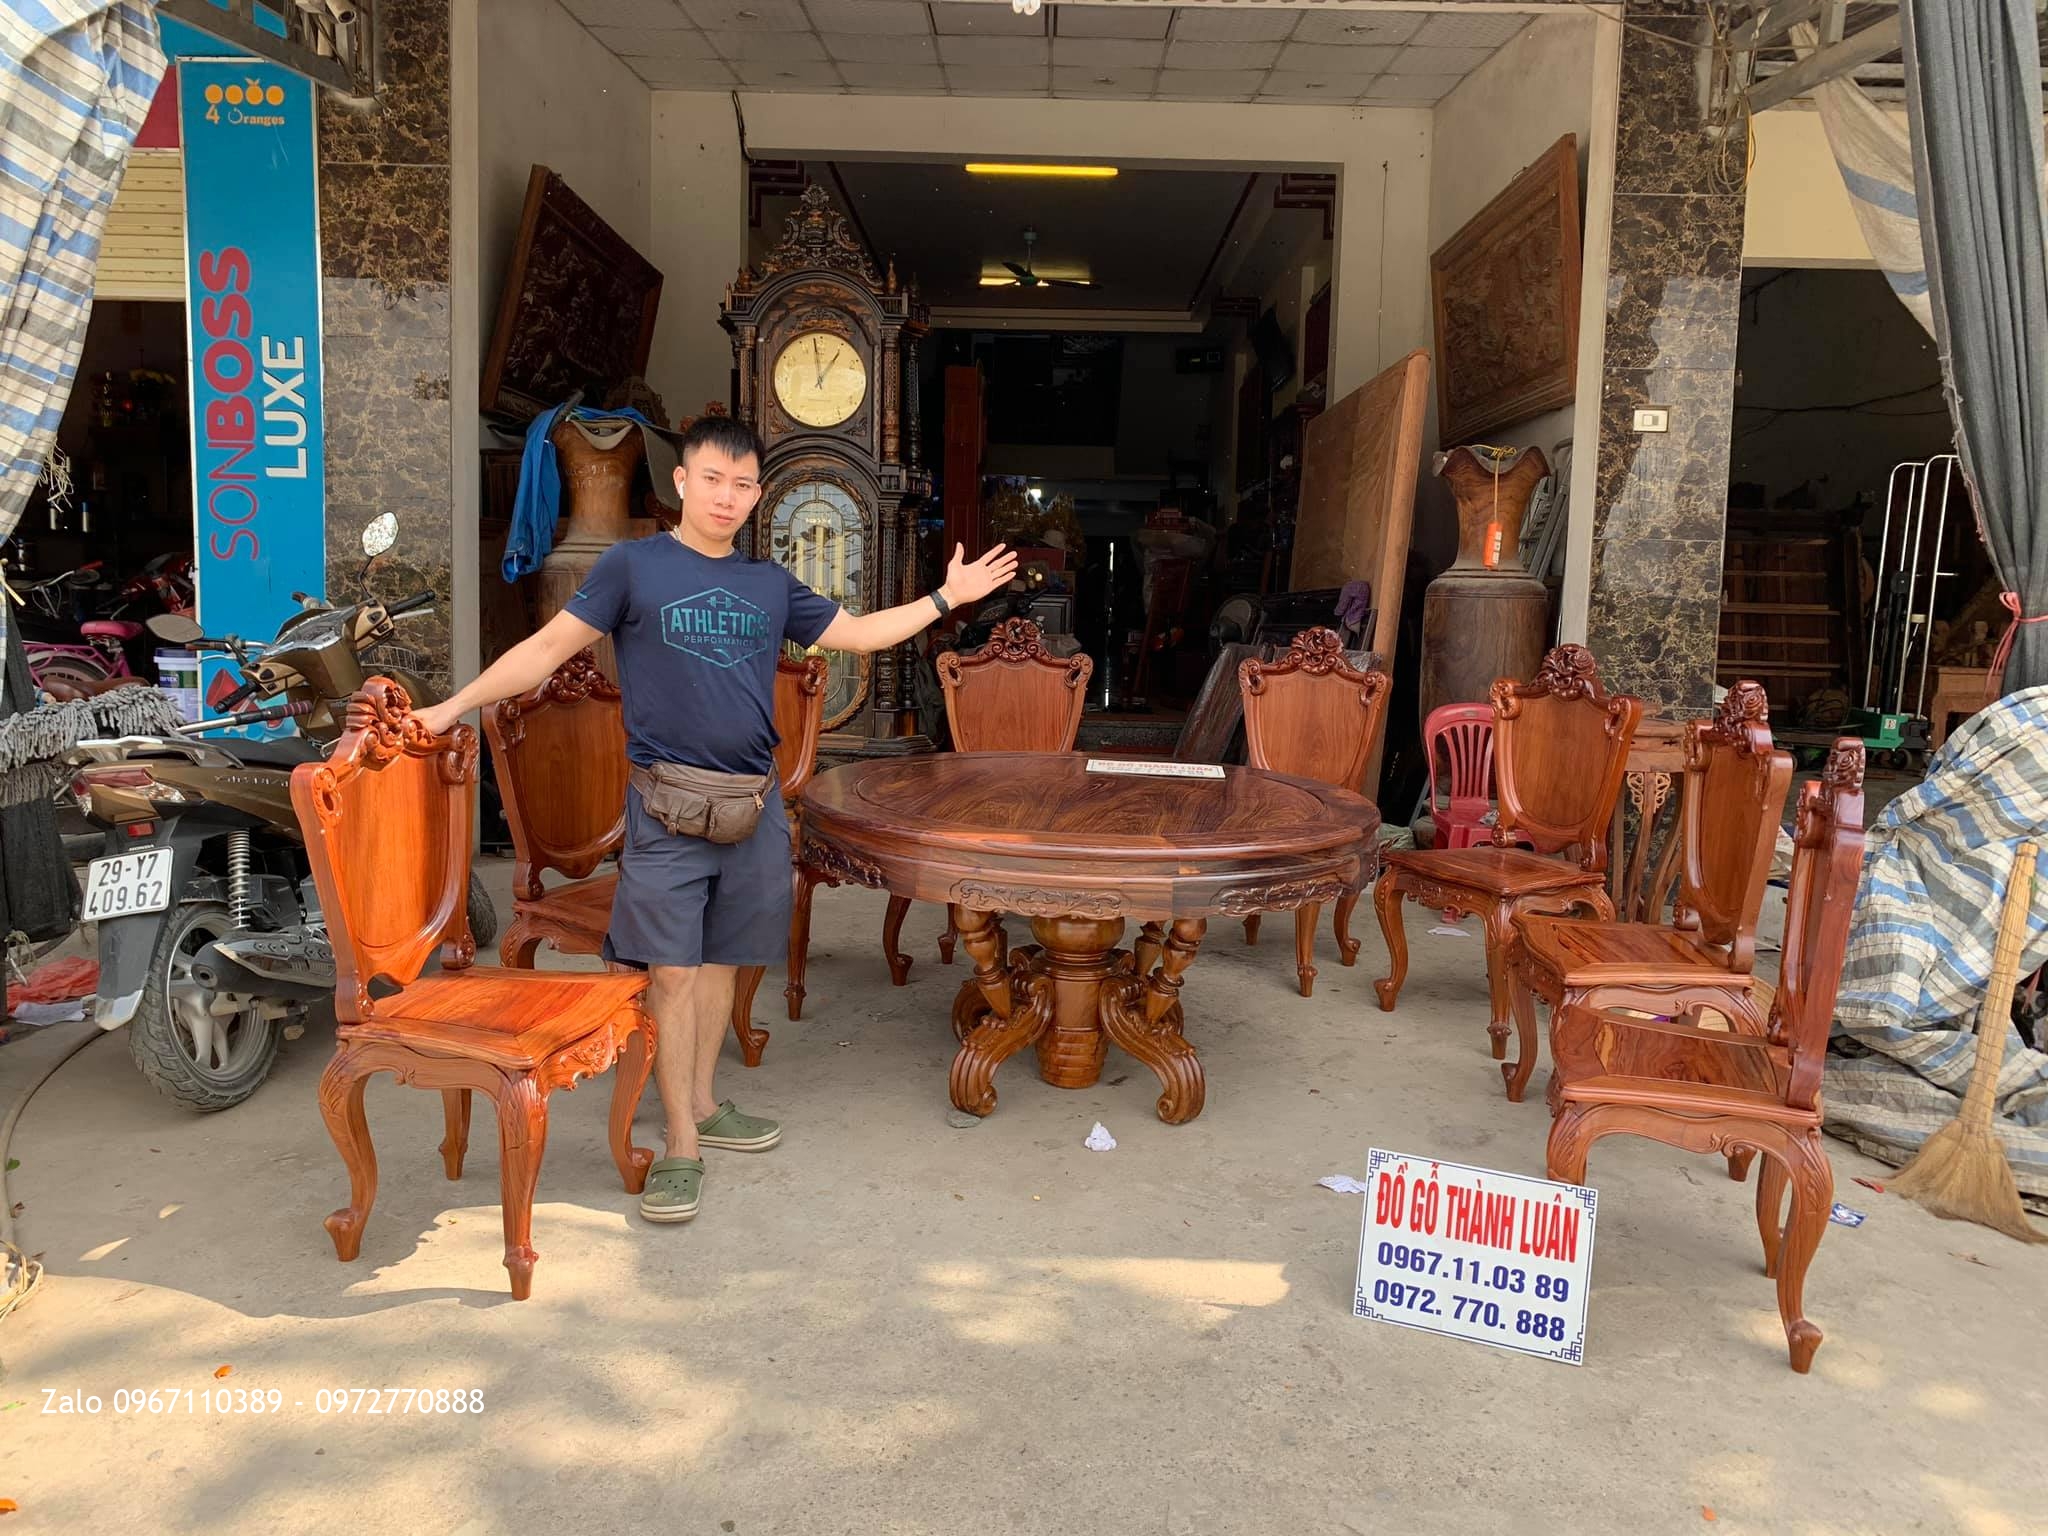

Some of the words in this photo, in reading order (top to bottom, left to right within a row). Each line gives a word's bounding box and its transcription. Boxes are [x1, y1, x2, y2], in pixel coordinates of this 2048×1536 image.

[206, 104, 220, 125] 4
[227, 107, 285, 126] Oranges
[199, 246, 260, 561] SONBOSS
[261, 335, 308, 479] LUXE
[88, 880, 163, 916] 409.62
[98, 853, 159, 887] 29-Y7
[1376, 1161, 1408, 1229] ĐỒ
[1409, 1161, 1440, 1236] GỖ
[1445, 1178, 1516, 1251] THÀNH
[1519, 1192, 1580, 1263] LUÂN
[1377, 1241, 1526, 1294] 0967.11.03
[1534, 1274, 1569, 1302] 89
[1374, 1279, 1442, 1316] 0972.
[1452, 1295, 1506, 1329] 770.
[1516, 1309, 1565, 1342] 888
